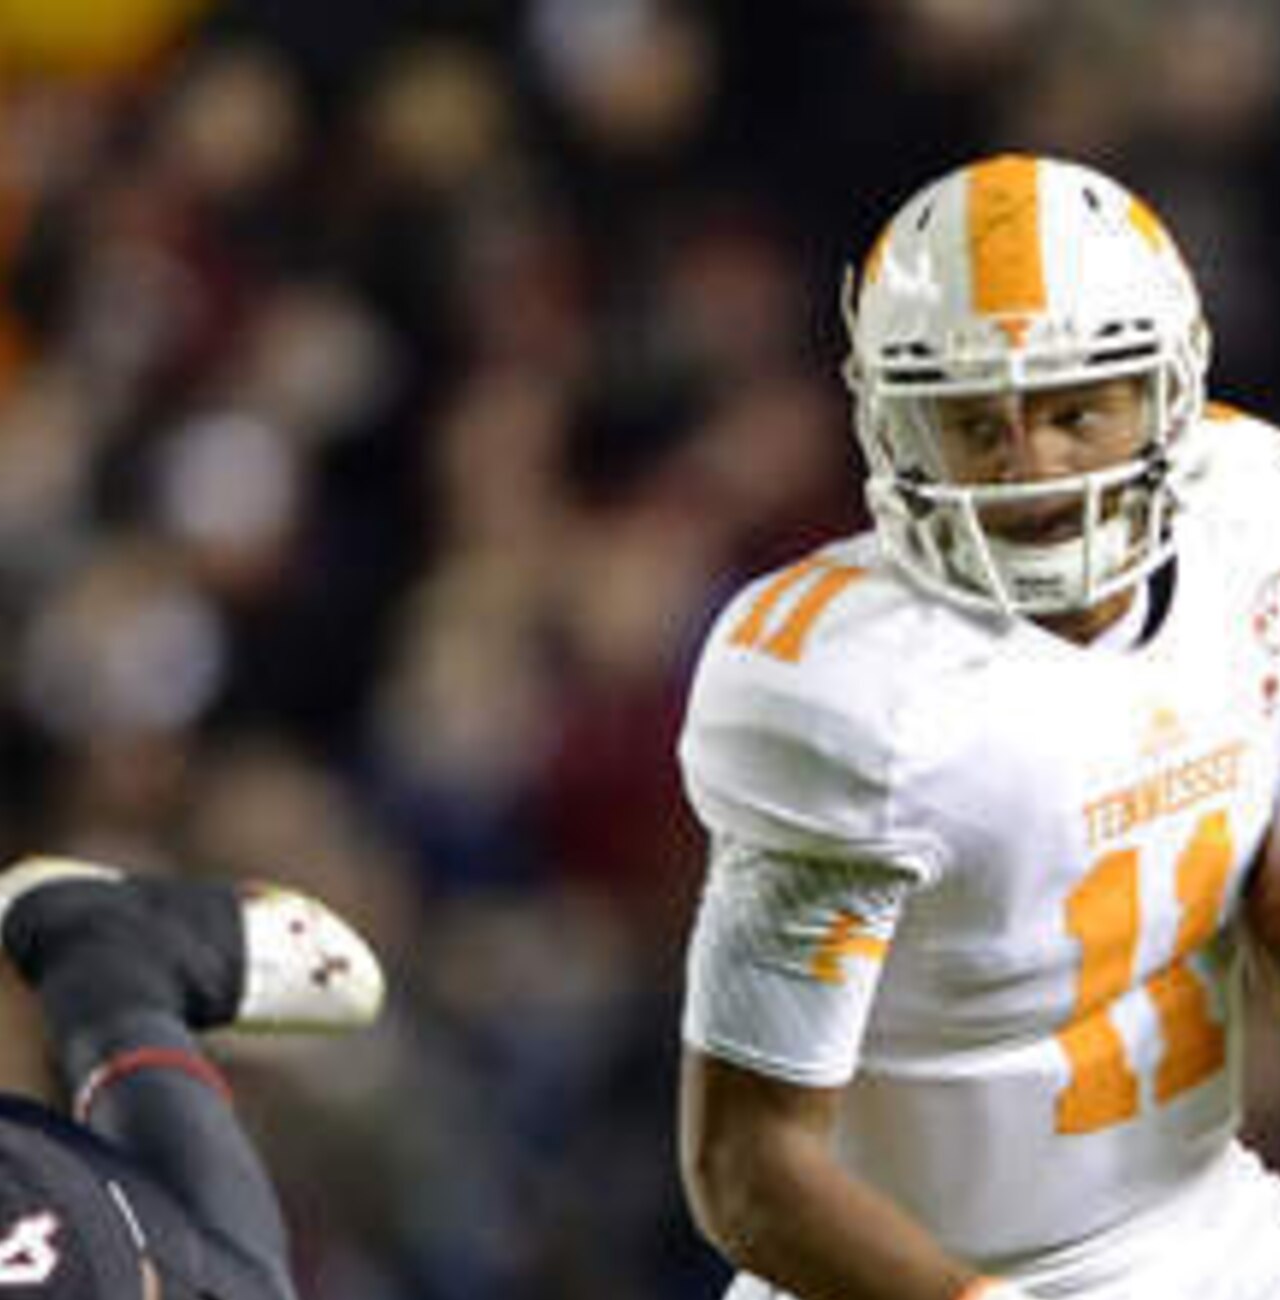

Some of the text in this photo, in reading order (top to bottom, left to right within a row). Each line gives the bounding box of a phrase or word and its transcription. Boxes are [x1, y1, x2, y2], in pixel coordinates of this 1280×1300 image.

[729, 556, 866, 665] 11
[1082, 739, 1250, 849] TENNESSE
[1052, 805, 1234, 1136] 11
